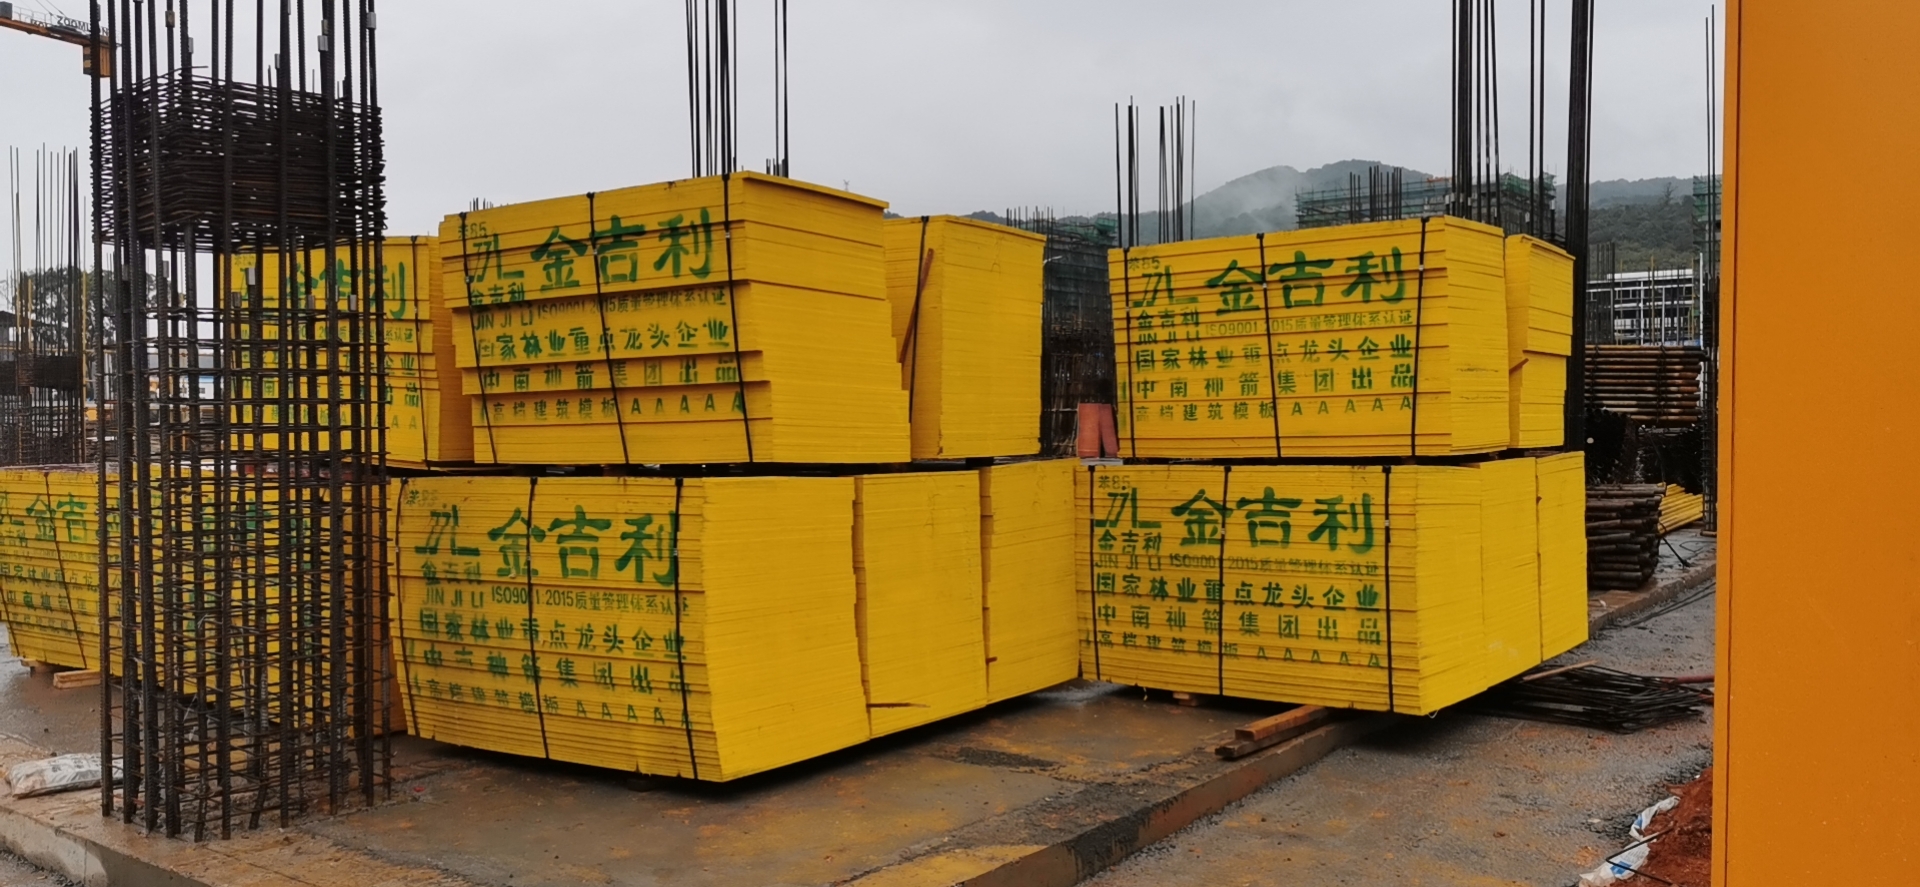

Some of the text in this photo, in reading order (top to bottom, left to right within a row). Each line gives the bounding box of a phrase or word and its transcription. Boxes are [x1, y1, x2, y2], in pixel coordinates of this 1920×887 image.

[56, 14, 109, 37] ZOOMLN
[530, 207, 713, 293] 金吉利
[1204, 246, 1405, 317] 金吉利
[474, 307, 533, 331] JIN JI LI
[1136, 306, 1200, 331] 金吉利
[478, 318, 730, 361] 国家林业重点龙头企业
[1136, 330, 1200, 346] JIN JI LI
[1136, 333, 1414, 373] 国家林业重点龙头企业
[1171, 486, 1375, 555] 金吉利
[487, 505, 677, 586] 金吉利
[1098, 529, 1162, 554] 金吉利
[421, 560, 481, 585] 金吉利
[1095, 554, 1161, 571] JIN JI LI
[423, 587, 484, 608] JIN JI LI
[492, 585, 690, 617] ISO901:2015质量管理体系认证
[1096, 572, 1380, 613] 国家林业重点龙头企业
[419, 606, 687, 661] 国家林业重点龙头企业
[1098, 603, 1382, 645] 中南神箭集团出品
